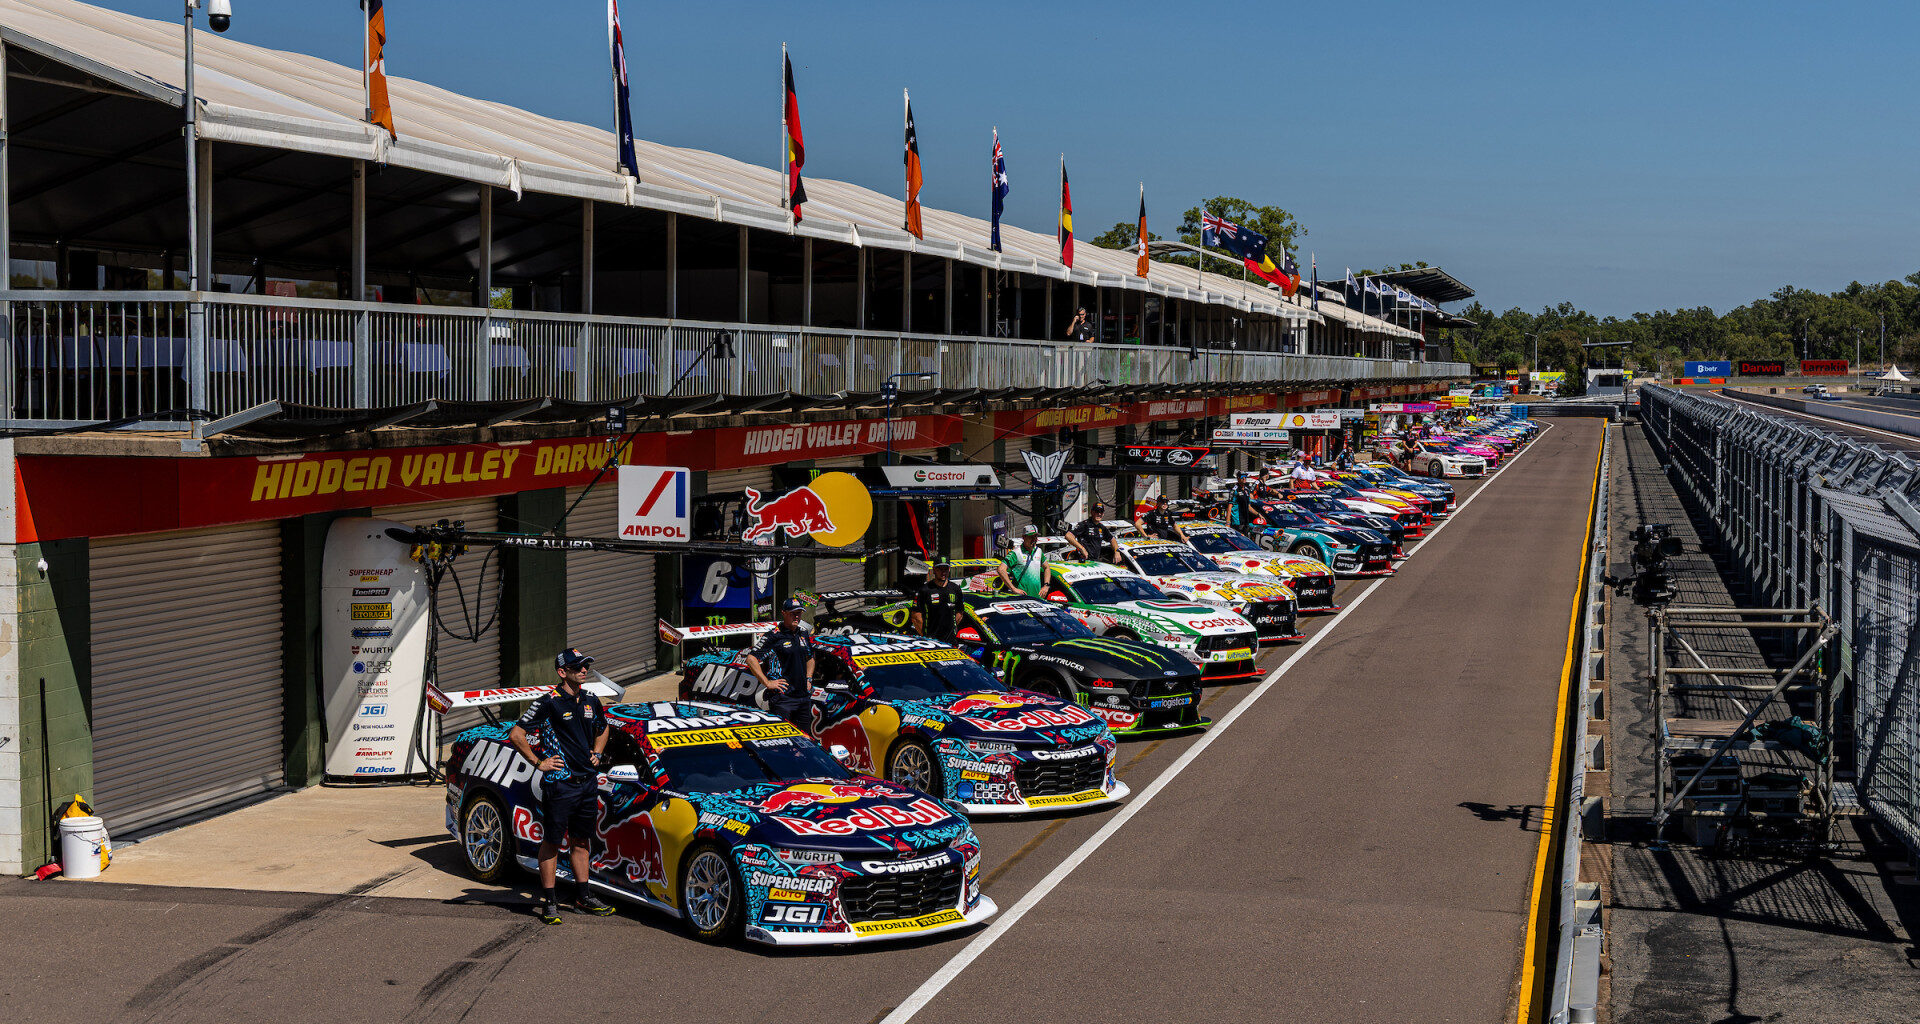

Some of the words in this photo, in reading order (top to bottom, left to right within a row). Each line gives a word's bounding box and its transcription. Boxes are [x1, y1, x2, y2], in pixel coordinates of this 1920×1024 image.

[1742, 363, 1781, 373] Darwin
[1803, 362, 1847, 372] Larrakia
[1036, 408, 1063, 427] HIDDEN
[1065, 407, 1091, 425] VALLEY
[1245, 417, 1271, 426] Repco
[744, 428, 803, 455] HIDDEN
[807, 424, 861, 448] VALLEY
[868, 421, 917, 443] DARWIN
[1129, 449, 1161, 457] GROVE
[251, 456, 392, 501] HIDDEN
[400, 449, 519, 487] VALLEY
[928, 472, 965, 480] Castrol
[622, 524, 686, 538] AMPOL
[349, 568, 394, 577] SUPERCHEAP
[701, 561, 732, 604] 6
[822, 590, 853, 599] tech
[1300, 587, 1317, 597] APEX
[1189, 617, 1249, 630] Castrol
[1256, 614, 1274, 624] APEX
[1164, 634, 1181, 642] dba
[850, 640, 951, 655] AMPOL
[854, 653, 918, 666] NATIONAL
[1227, 651, 1250, 660] ultimate
[1038, 654, 1056, 662] FAW
[1053, 657, 1084, 672] TRUCKS
[1093, 678, 1113, 687] dba
[358, 686, 389, 695] Partners
[361, 706, 385, 715] JGI
[1109, 703, 1130, 711] TRUCKS
[648, 711, 782, 733] AMPOL
[923, 718, 945, 732] SUPER
[650, 728, 733, 747] NATIONAL
[735, 723, 798, 740] STORAGE
[752, 737, 793, 747] Feeney
[1031, 747, 1098, 761] COMPLETE
[356, 766, 396, 774] ACDelco
[947, 757, 1012, 776] SUPERCHEAP
[975, 782, 1006, 791] QUAD
[974, 791, 1006, 799] LOCK
[1029, 797, 1075, 806] NATIONAL
[699, 812, 720, 824] MAKE
[723, 818, 751, 836] SUPER
[745, 844, 761, 852] Shaw
[742, 855, 767, 866] Partners
[792, 851, 836, 862] WÜRTH
[861, 854, 951, 874] COMPLETE
[751, 871, 834, 894] SUPERCHEAP
[773, 891, 802, 899] AUTO
[764, 905, 821, 924] JGI
[855, 921, 918, 933] NATIONAL
[919, 911, 962, 926] STORAGE
